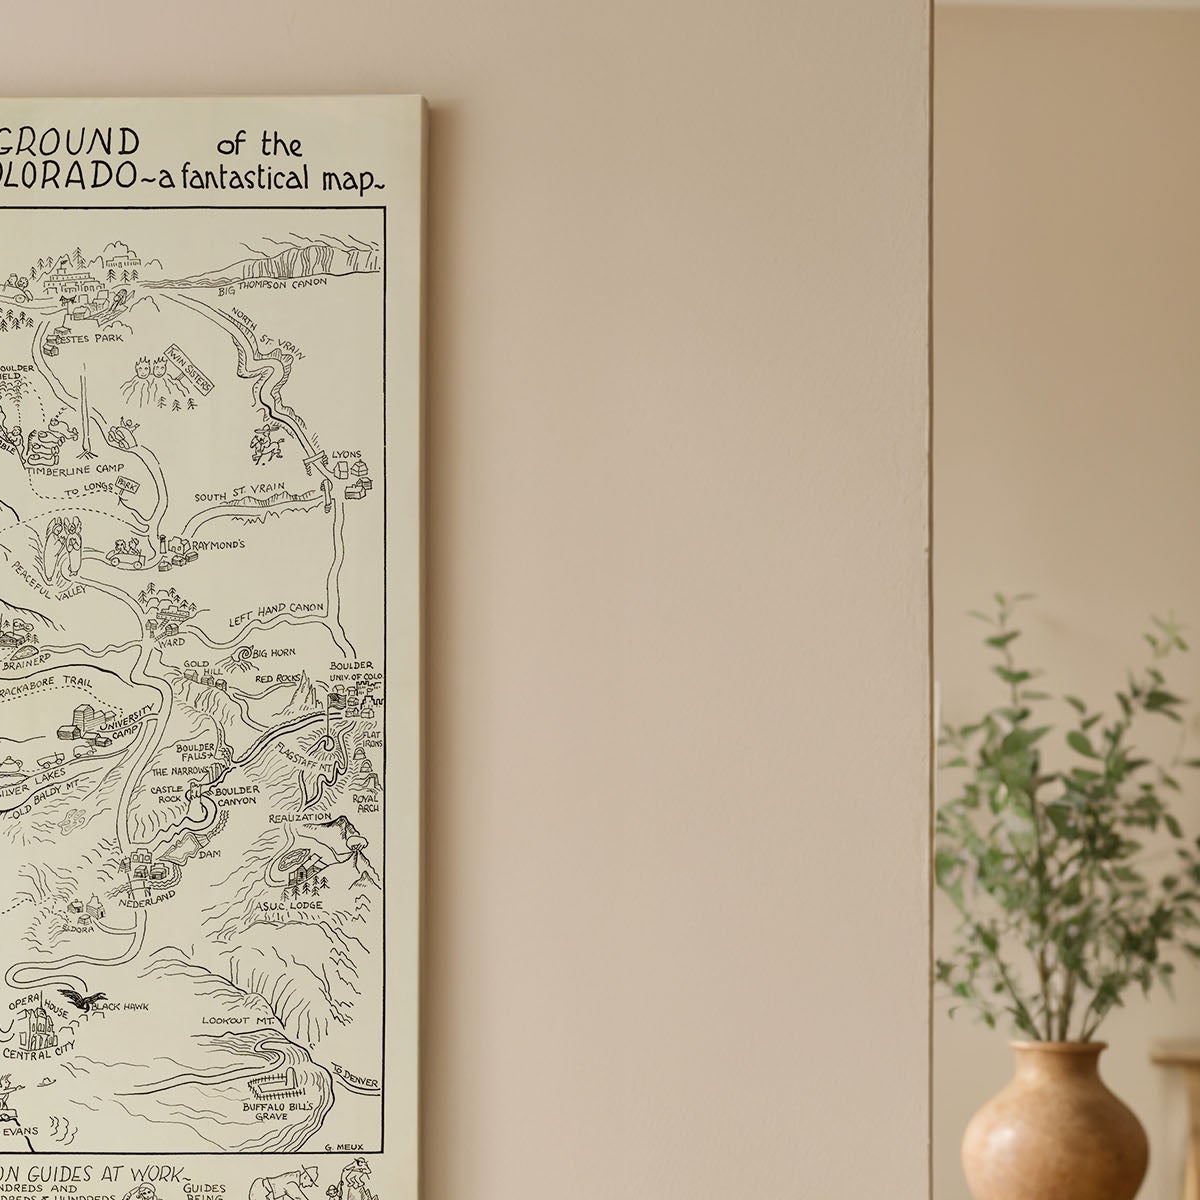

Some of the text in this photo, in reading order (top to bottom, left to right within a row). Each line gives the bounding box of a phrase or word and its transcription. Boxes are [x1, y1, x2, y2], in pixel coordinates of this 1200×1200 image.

[217, 130, 246, 155] of
[262, 130, 302, 156] the
[182, 162, 308, 190] fantastical
[218, 278, 327, 296] BIG THOMPSON CANON
[95, 334, 123, 342] PARK
[232, 307, 306, 361] NORTH VRAIN
[185, 364, 211, 391] SISTERS
[332, 450, 362, 459] LYONS
[26, 464, 125, 477] TIMBERLINE CAMP
[64, 482, 113, 496] TO LONGS
[194, 482, 285, 502] SOUTH VRAIN
[11, 561, 89, 601] PEACEFUL VALLEY
[229, 603, 324, 627] LEFT HAND CANON
[158, 638, 185, 648] WARD
[252, 648, 296, 658] BIG HORN
[2, 653, 51, 671] BRAINERD
[330, 661, 374, 670] BOULDER
[204, 668, 223, 676] HILL
[62, 675, 93, 688] TRAIL
[255, 674, 301, 683] RED ROCKS
[112, 725, 139, 740] CAMP
[176, 743, 214, 753] BOULDER
[275, 741, 317, 768] FLAGSTAFF
[34, 768, 66, 785] LAKES
[152, 768, 169, 776] THE
[151, 785, 183, 794] CASTLE
[215, 785, 260, 796] BOULDER
[33, 786, 62, 806] BALDY
[158, 795, 182, 803] ROCK
[217, 796, 256, 806] CANYON
[269, 813, 332, 823] REALIZATION
[199, 850, 221, 859] DAM
[118, 889, 176, 908] NEDERLAND
[290, 901, 323, 910] LODGE
[9, 993, 69, 1019] OPERA HOUSE
[123, 1002, 150, 1011] HAWK
[202, 1017, 250, 1025] LOOKOUT
[2, 1040, 75, 1061] CENTRAL CITY
[343, 1070, 379, 1088] DENVER
[242, 1103, 285, 1112] BUFFALO
[255, 1112, 288, 1121] GRAVE
[3, 1127, 39, 1137] EVANS
[27, 1165, 93, 1183] GUIDES
[101, 1165, 124, 1182] AT
[51, 1184, 78, 1193] AND
[183, 1184, 226, 1193] GUIDES
